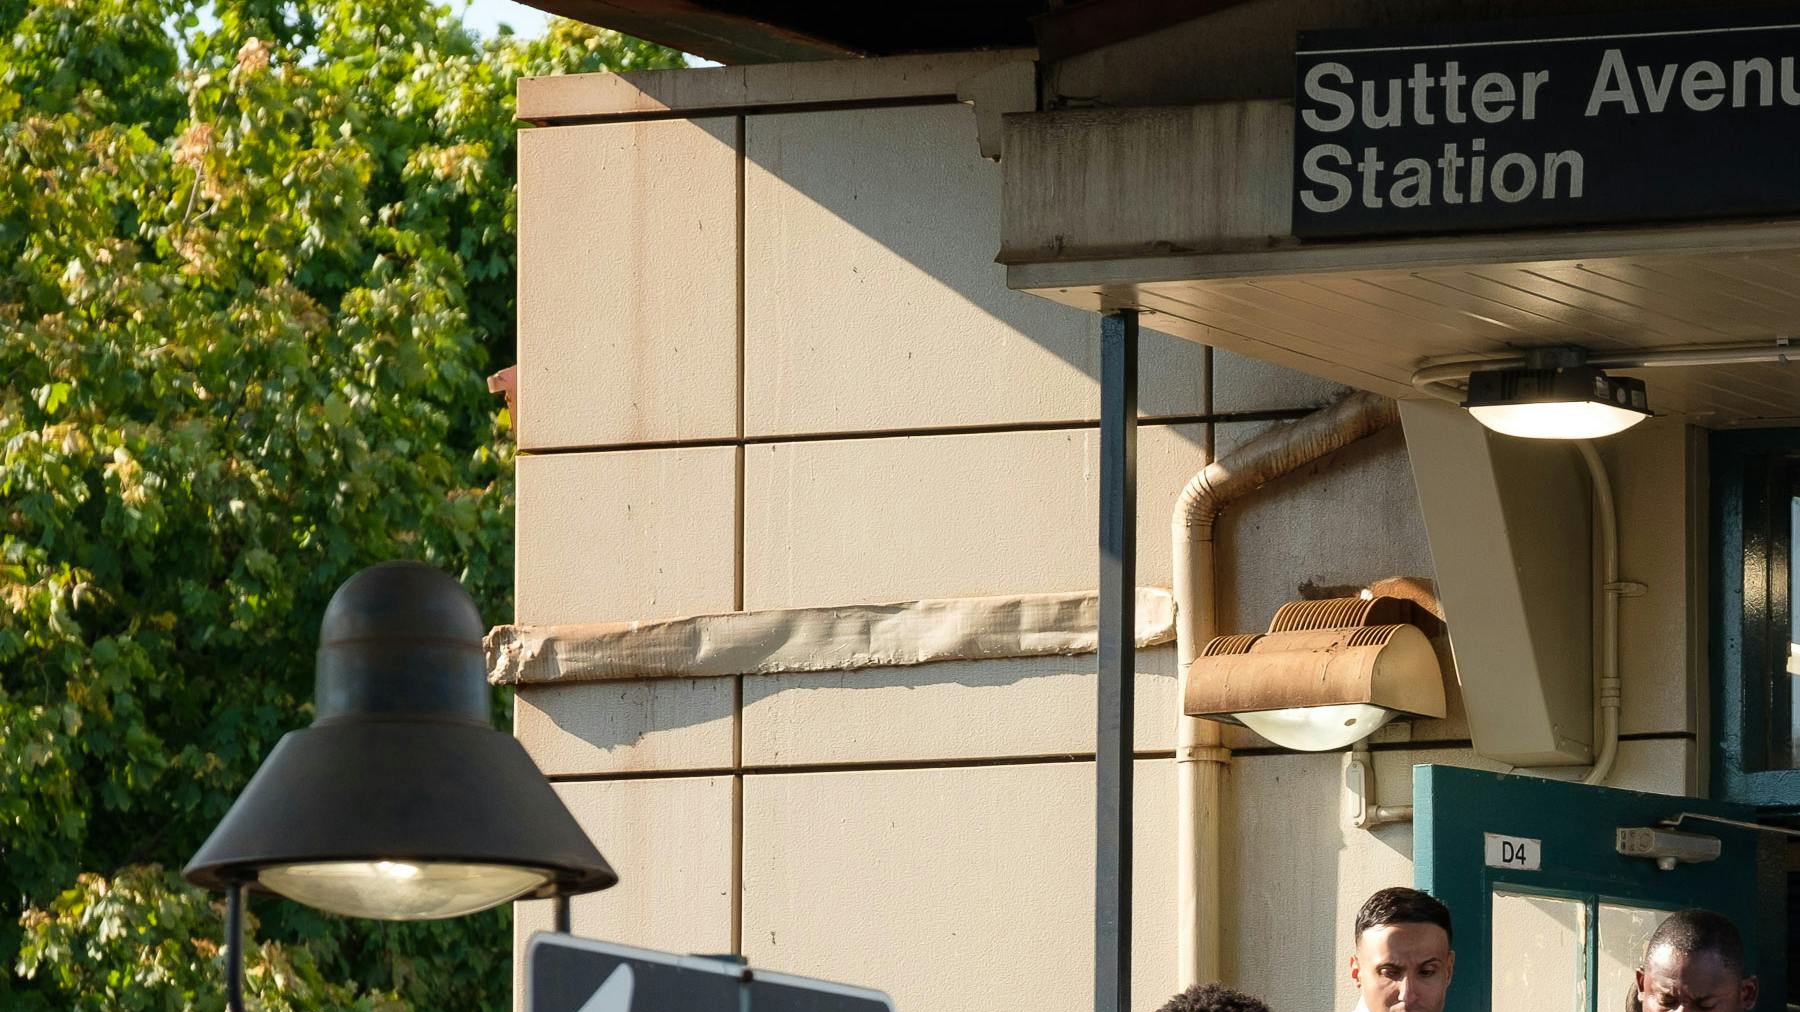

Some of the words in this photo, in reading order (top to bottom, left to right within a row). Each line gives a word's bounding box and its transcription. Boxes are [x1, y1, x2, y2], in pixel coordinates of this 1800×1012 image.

[1301, 61, 1550, 133] Sutter
[1299, 137, 1585, 214] Station
[1502, 840, 1527, 865] D4
